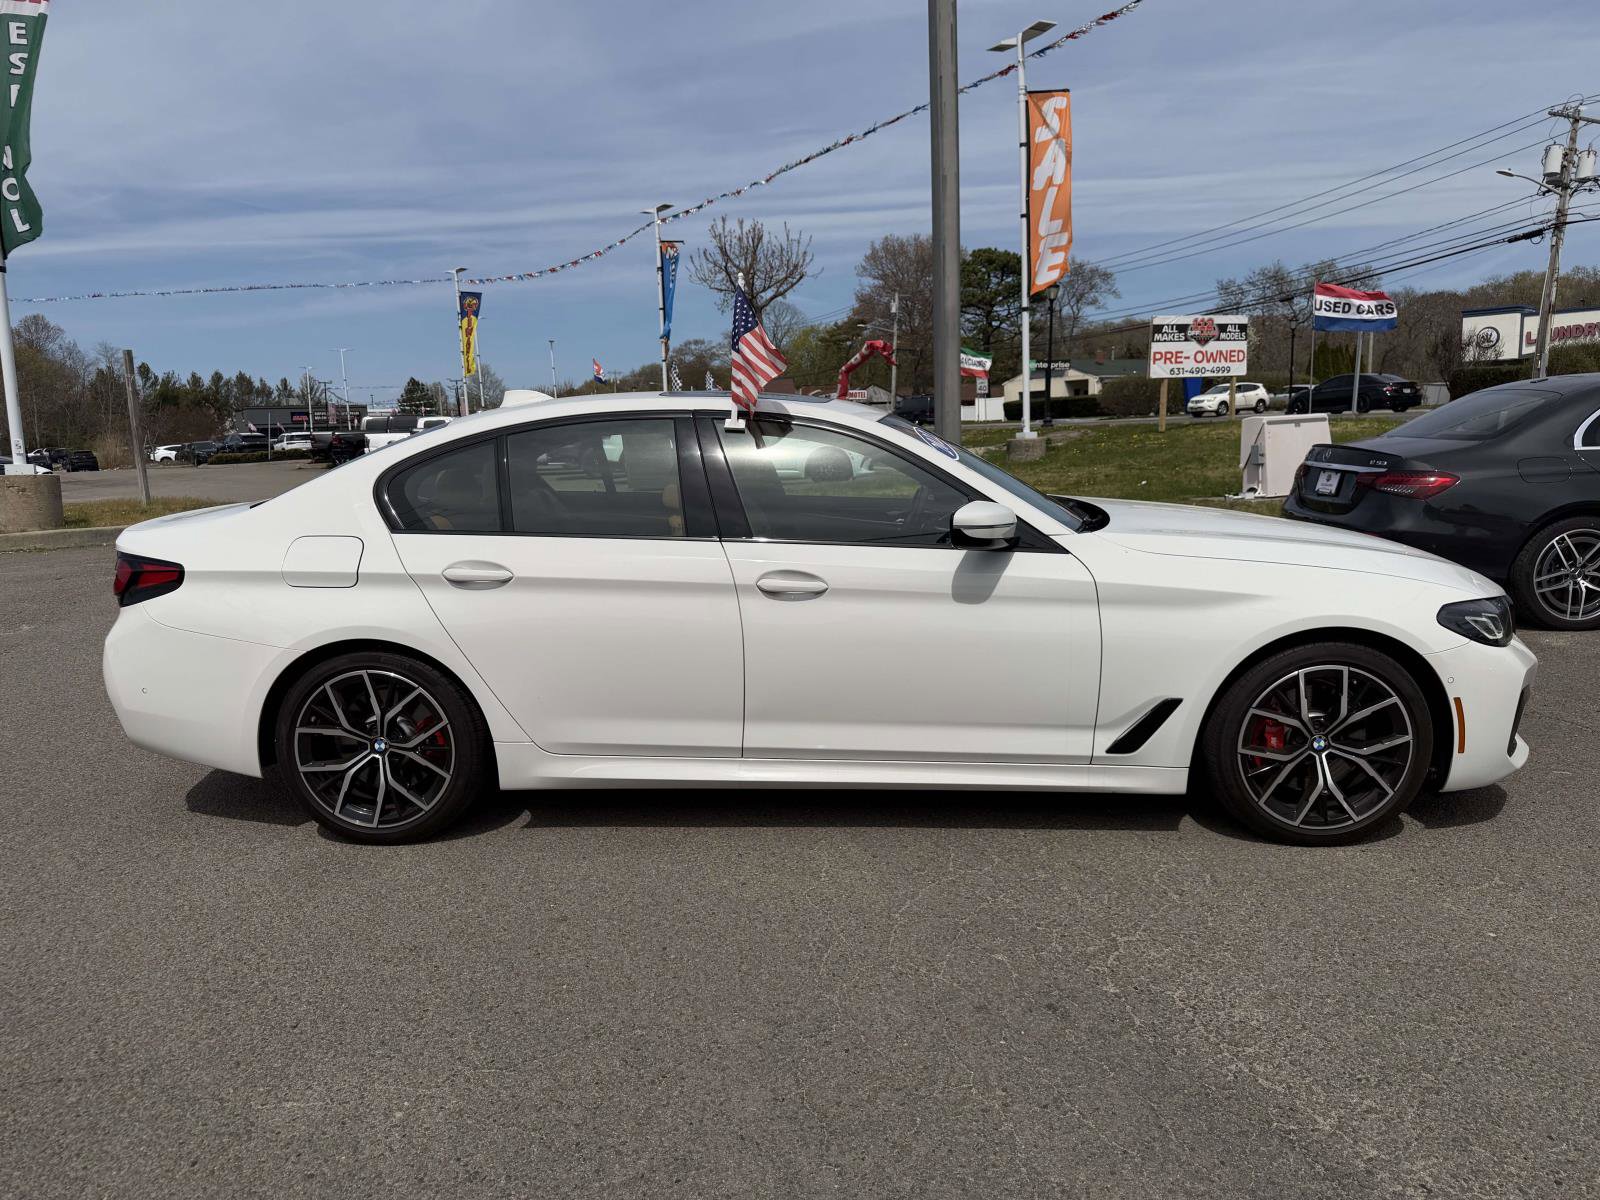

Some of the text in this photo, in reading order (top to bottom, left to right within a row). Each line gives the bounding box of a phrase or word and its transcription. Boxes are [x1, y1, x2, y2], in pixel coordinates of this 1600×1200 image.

[2, 21, 31, 233] ESOL
[1032, 96, 1069, 286] SALE
[1314, 299, 1395, 315] USED CARS
[1162, 325, 1178, 333] ALL
[1226, 324, 1240, 332] ALL
[1154, 333, 1185, 341] MAKES
[1220, 332, 1245, 340] MODELS
[1525, 322, 1600, 345] LUNDR
[1152, 349, 1246, 365] PRE- OWNED
[1029, 360, 1071, 370] enteprise
[1169, 366, 1231, 375] 631-490-4999
[978, 384, 987, 392] 40
